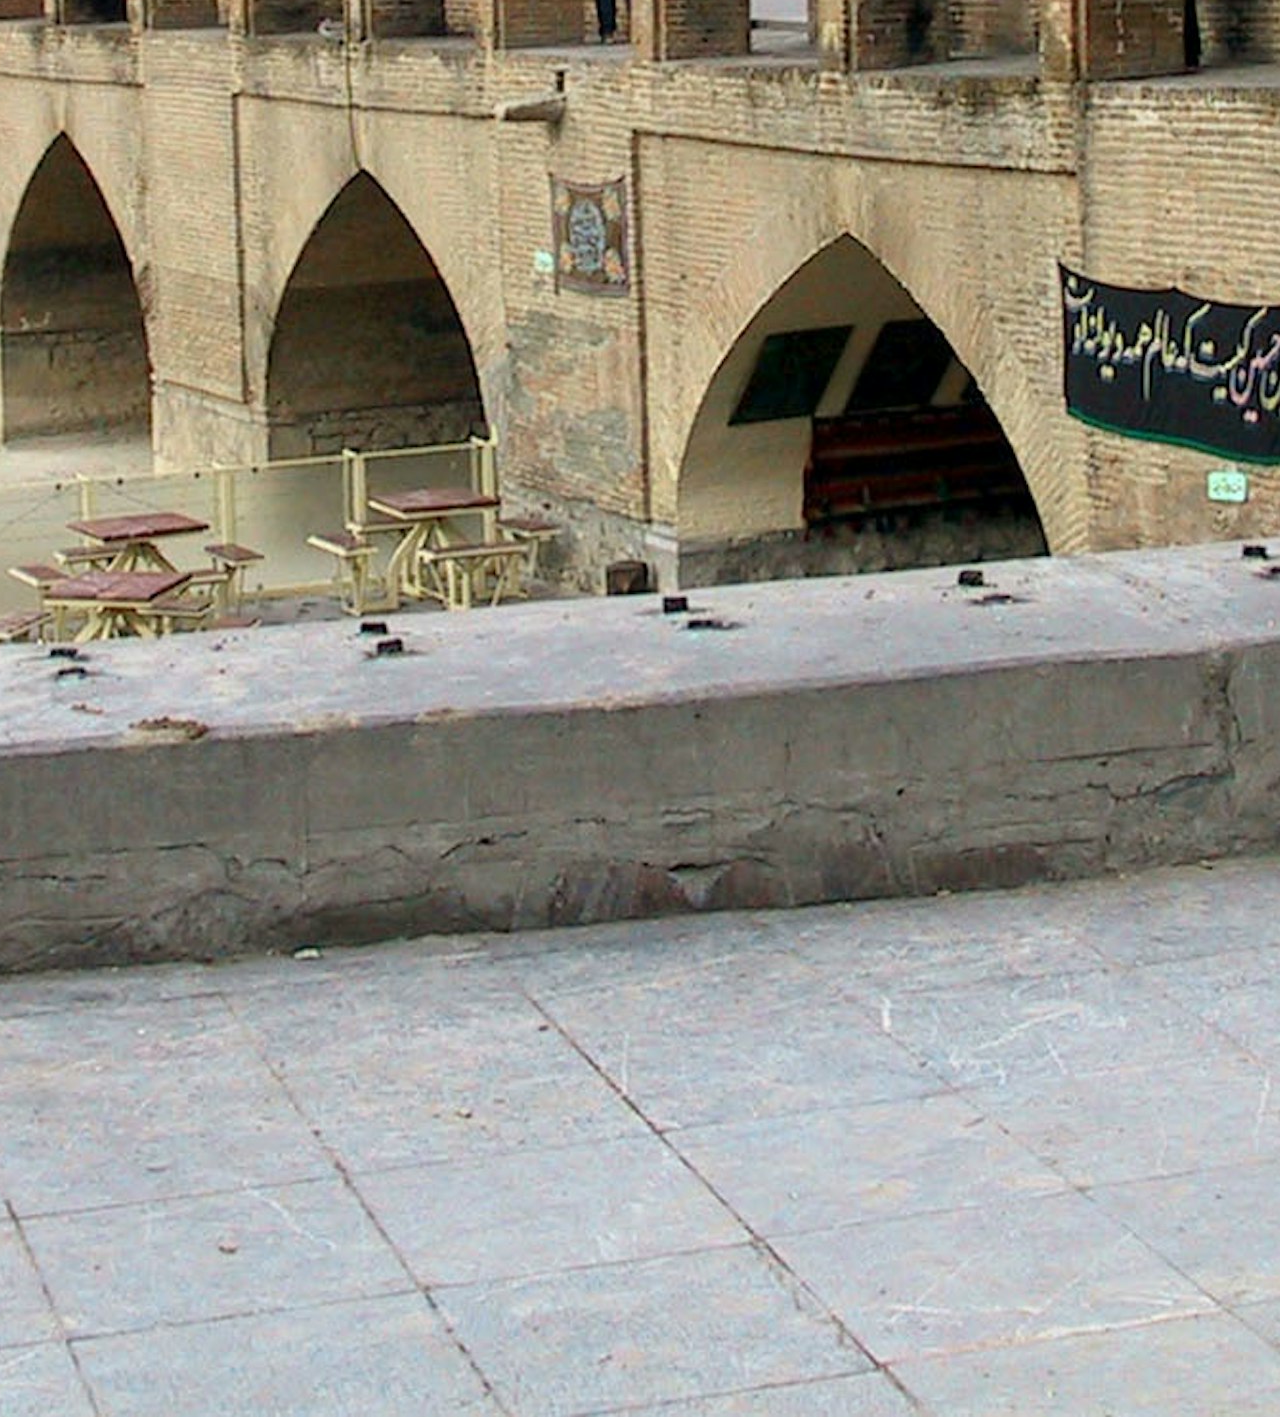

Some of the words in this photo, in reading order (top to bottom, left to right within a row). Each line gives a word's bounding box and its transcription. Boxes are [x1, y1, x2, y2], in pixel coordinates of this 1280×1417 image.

[1143, 308, 1178, 401] عالم
[1175, 302, 1212, 370] که
[1189, 305, 1269, 402] کیست
